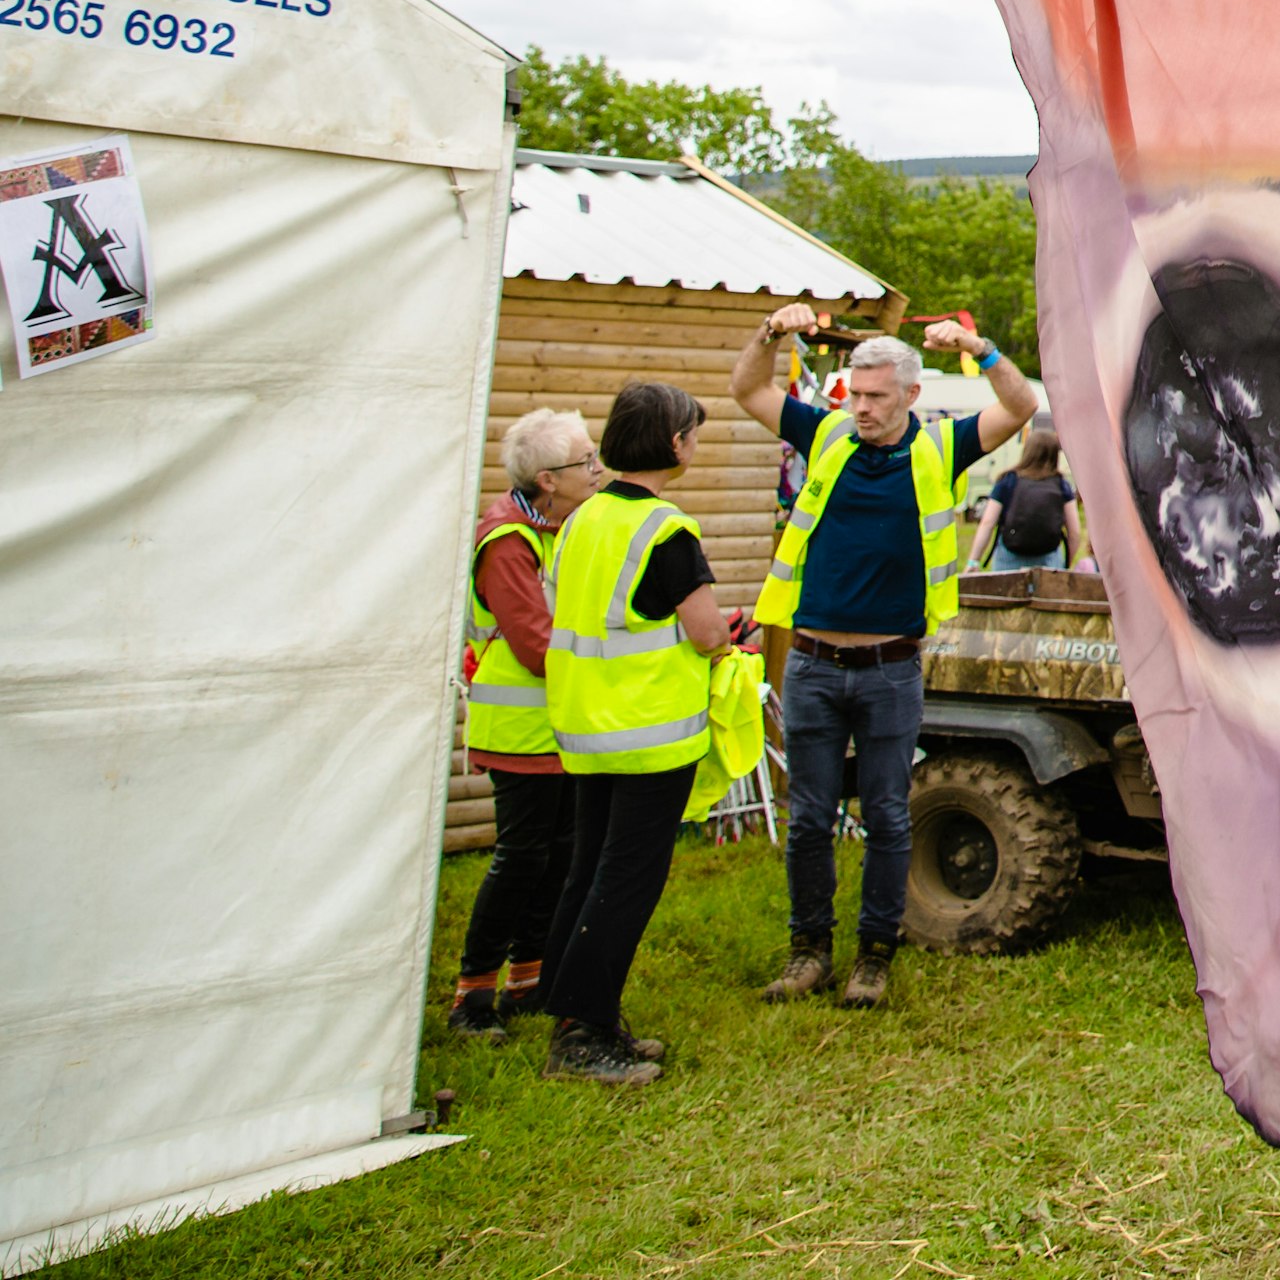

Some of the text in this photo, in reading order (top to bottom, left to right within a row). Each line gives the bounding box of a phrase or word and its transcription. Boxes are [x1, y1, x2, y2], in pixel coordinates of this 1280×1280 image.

[124, 9, 236, 58] 6932
[22, 193, 147, 328] A
[1034, 638, 1121, 665] KUBOT
